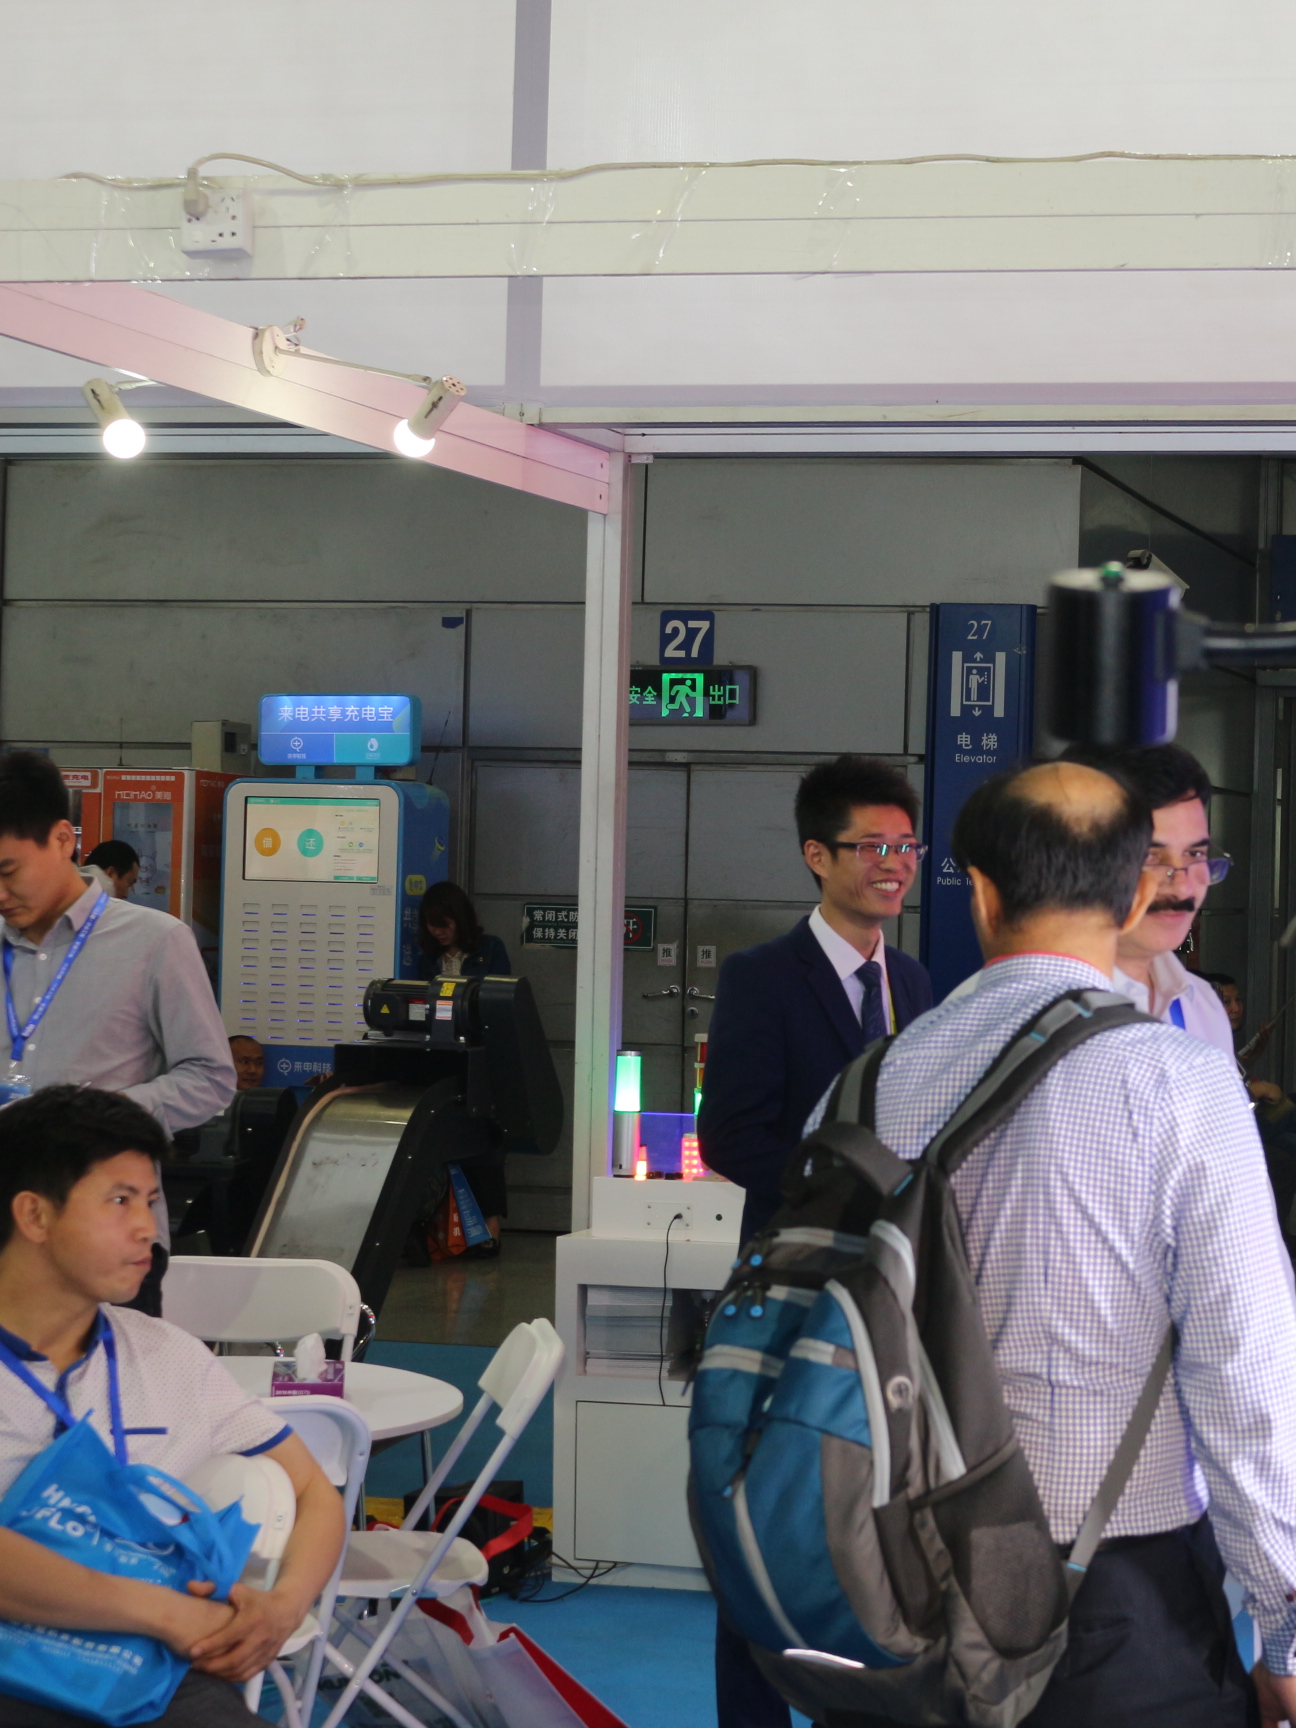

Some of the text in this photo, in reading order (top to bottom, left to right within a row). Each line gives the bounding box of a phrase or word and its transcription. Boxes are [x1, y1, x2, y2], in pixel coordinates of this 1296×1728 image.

[966, 620, 992, 641] 27
[664, 620, 711, 659] 27
[628, 684, 740, 705] 安全 出口
[278, 705, 394, 722] 来电共享充电宝
[957, 732, 998, 751] 电梯
[955, 753, 997, 764] Elevator
[936, 876, 962, 886] Public
[661, 947, 673, 958] 推
[701, 948, 712, 960] 推
